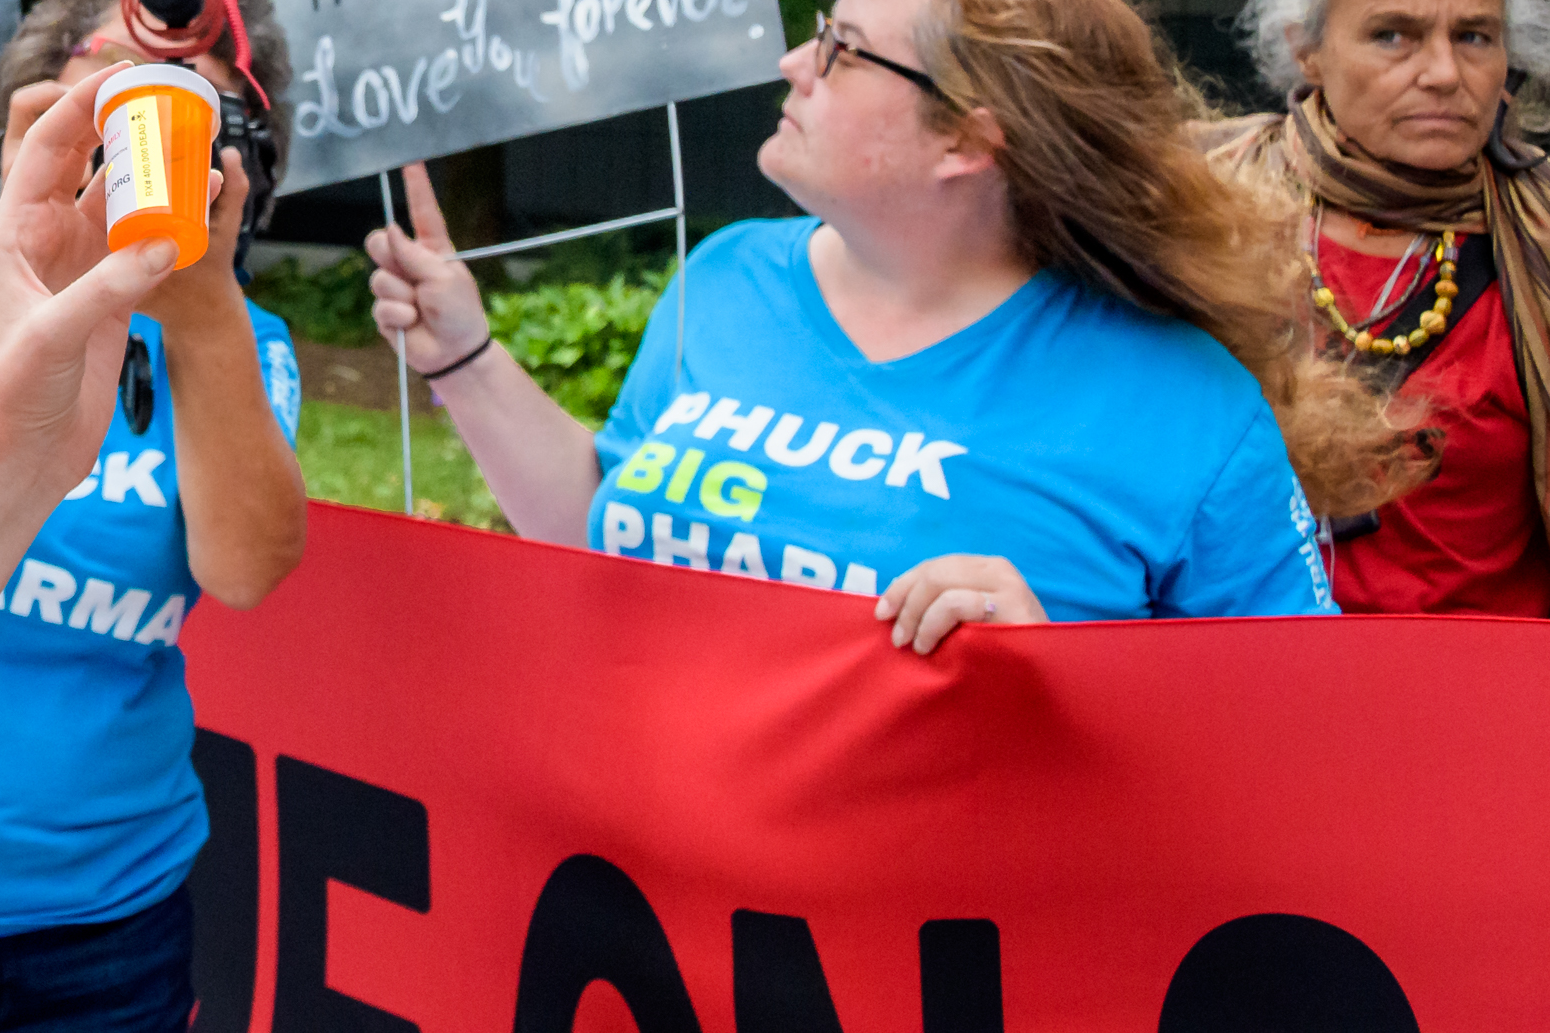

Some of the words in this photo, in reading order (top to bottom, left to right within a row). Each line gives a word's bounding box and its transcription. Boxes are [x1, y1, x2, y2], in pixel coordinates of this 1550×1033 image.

[294, 34, 463, 137] Love
[138, 123, 148, 147] DEAD
[141, 147, 152, 177] 400,000
[106, 173, 131, 199] N.ORG
[145, 179, 153, 196] RX#
[653, 391, 968, 500] PHUCK
[616, 441, 768, 522] BIG
[602, 501, 878, 596] PHAR
